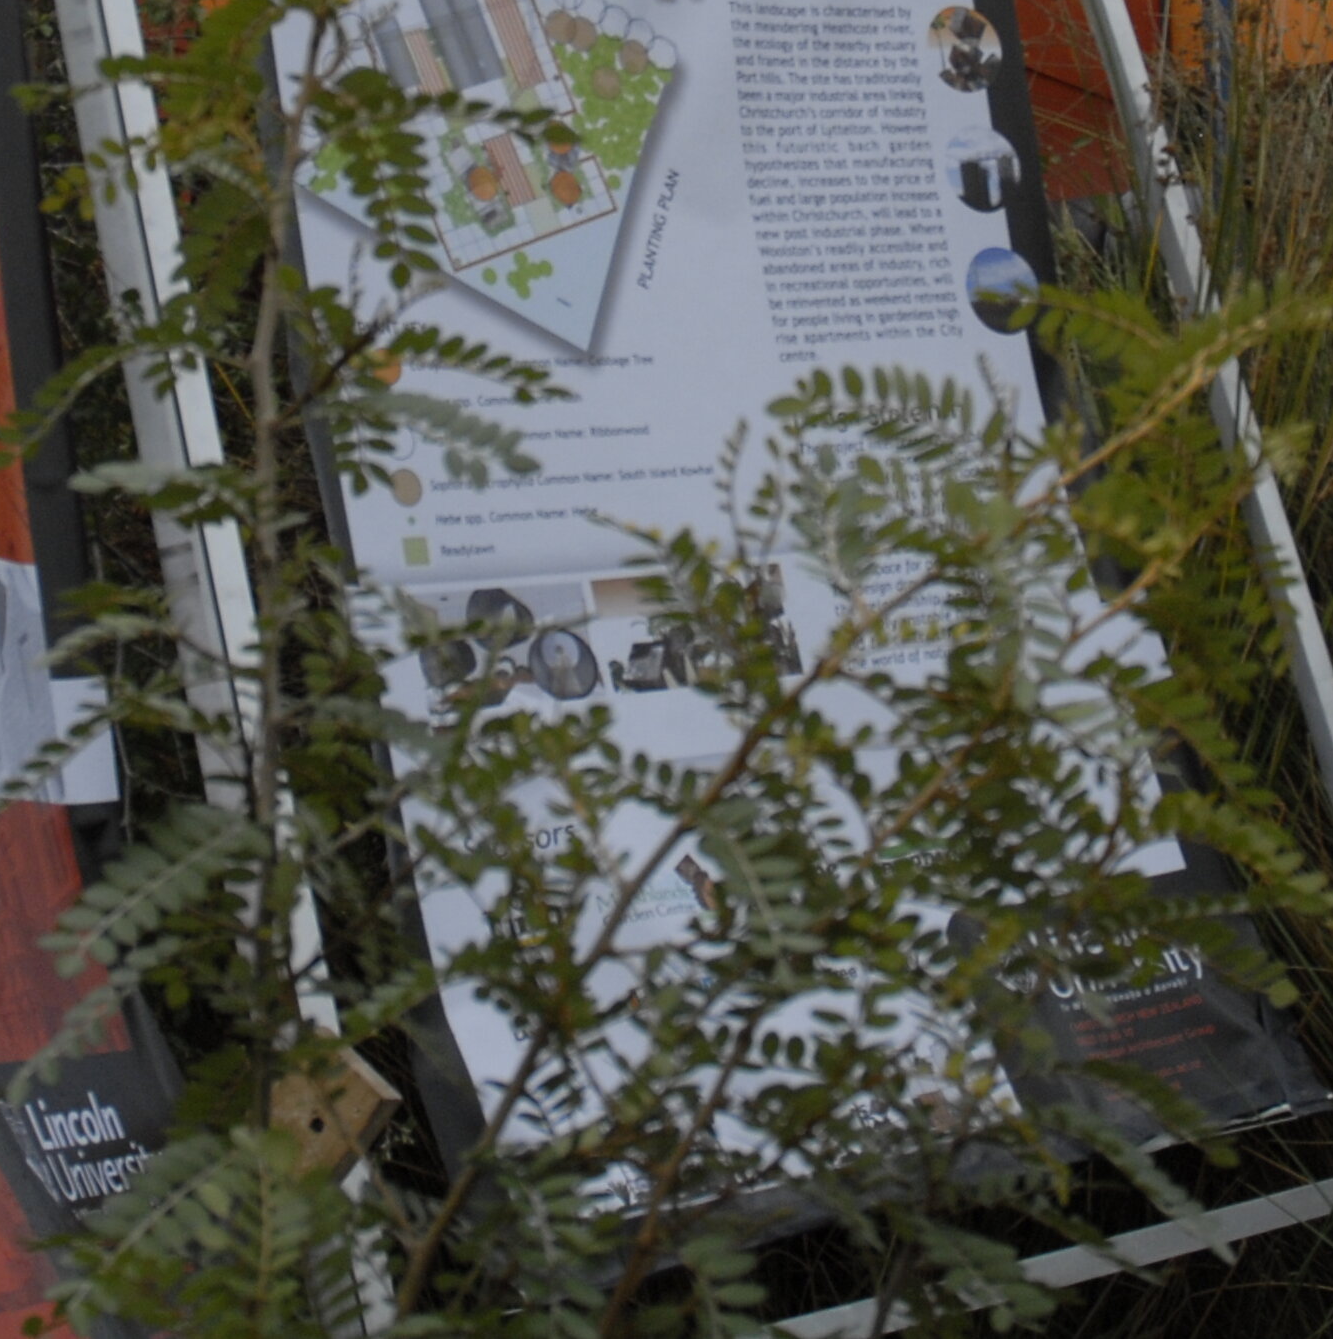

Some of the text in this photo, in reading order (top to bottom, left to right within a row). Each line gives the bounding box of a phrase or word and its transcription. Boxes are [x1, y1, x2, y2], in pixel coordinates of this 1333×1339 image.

[729, 1, 911, 20] This landscape is characterised by
[731, 19, 750, 32] the
[733, 37, 750, 48] the
[797, 39, 808, 51] of
[812, 39, 830, 51] the
[812, 56, 830, 67] the
[884, 57, 896, 69] by
[900, 56, 918, 67] the
[736, 71, 757, 83] Port
[789, 72, 808, 85] The
[812, 73, 830, 84] site
[834, 73, 852, 85] has
[868, 107, 879, 118] of
[883, 107, 926, 120] industry
[741, 125, 753, 136] to
[756, 125, 774, 136] the
[778, 126, 802, 139] port
[806, 125, 816, 136] of
[824, 158, 847, 170] that
[855, 175, 866, 186] to
[872, 174, 889, 185] the
[894, 174, 920, 186] price
[925, 173, 936, 184] of
[776, 194, 796, 205] and
[894, 208, 917, 219] lead
[637, 168, 680, 290] PLANTING PLAN
[811, 227, 866, 238] industrial
[928, 240, 948, 251] and
[863, 260, 874, 271] of
[916, 327, 935, 338] the
[940, 324, 963, 338] City
[618, 468, 647, 481] South
[489, 511, 533, 524] Common
[536, 509, 566, 519] Name:
[25, 1090, 126, 1151] Lincoln
[46, 1141, 159, 1201] Universi
